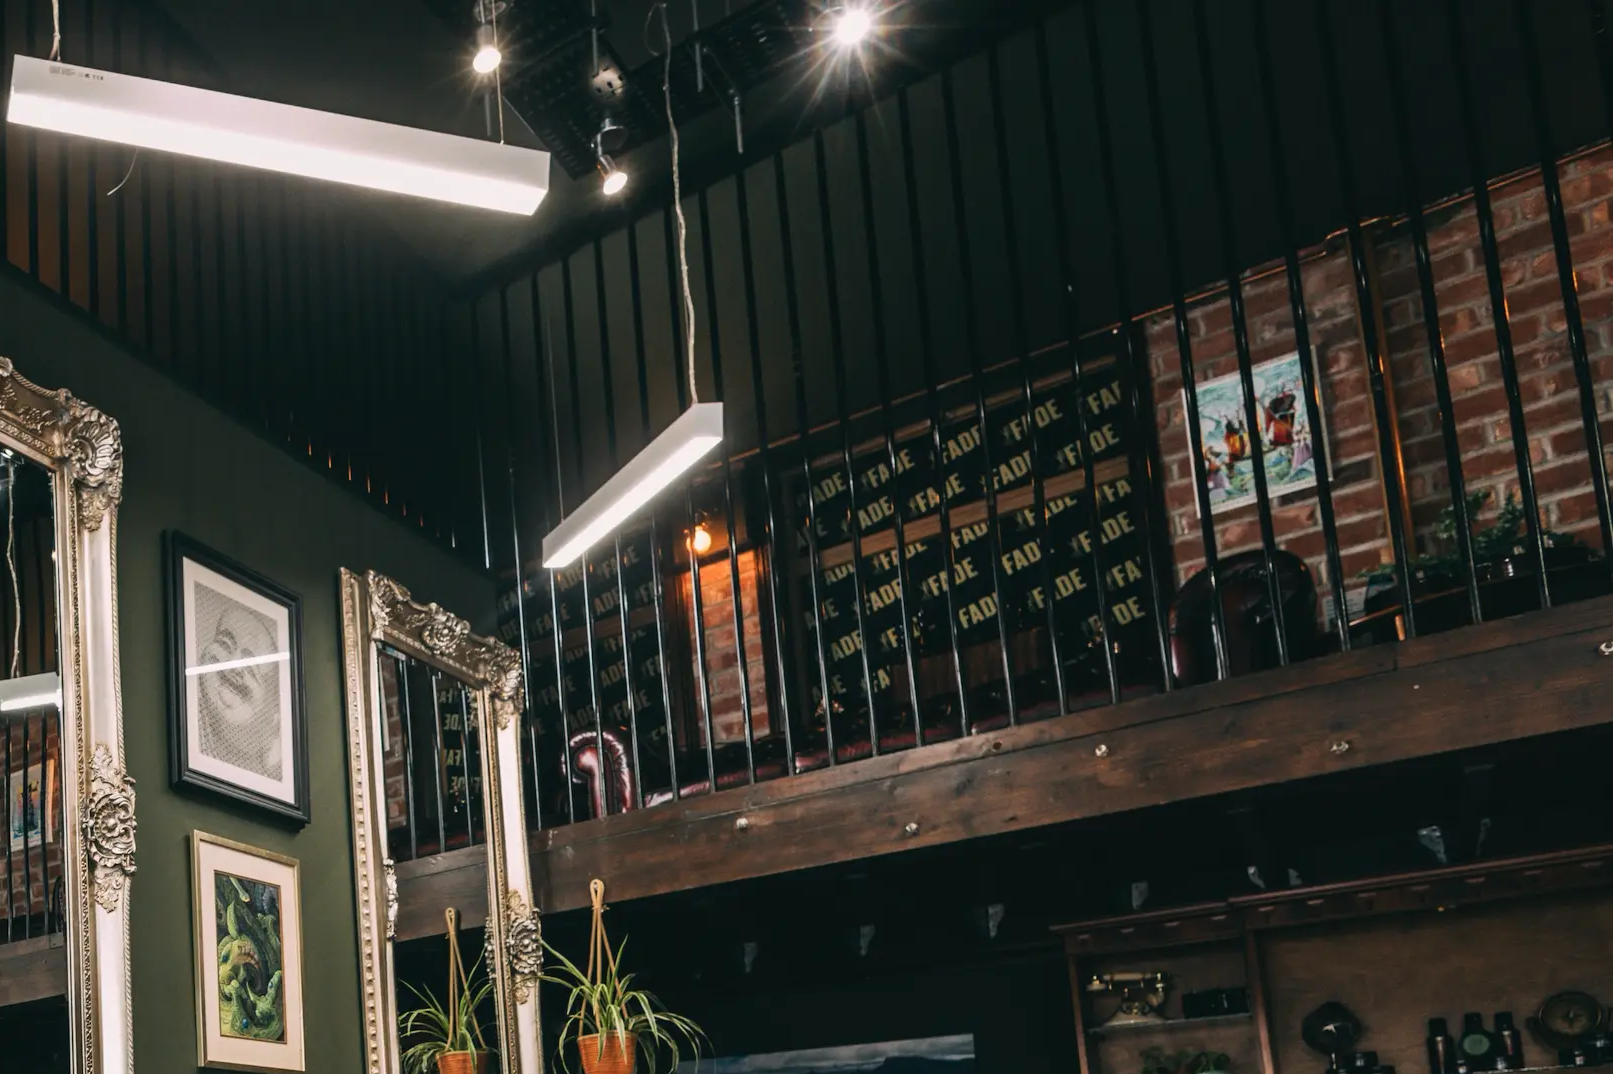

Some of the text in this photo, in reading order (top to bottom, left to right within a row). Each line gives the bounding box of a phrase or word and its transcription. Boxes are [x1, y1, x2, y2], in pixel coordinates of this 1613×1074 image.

[812, 471, 848, 505] ADE
[857, 495, 894, 531] ADE
[1063, 423, 1120, 466] FDE
[1001, 537, 1042, 576] FAD
[830, 629, 863, 662] ADE
[1031, 567, 1087, 609] FDE
